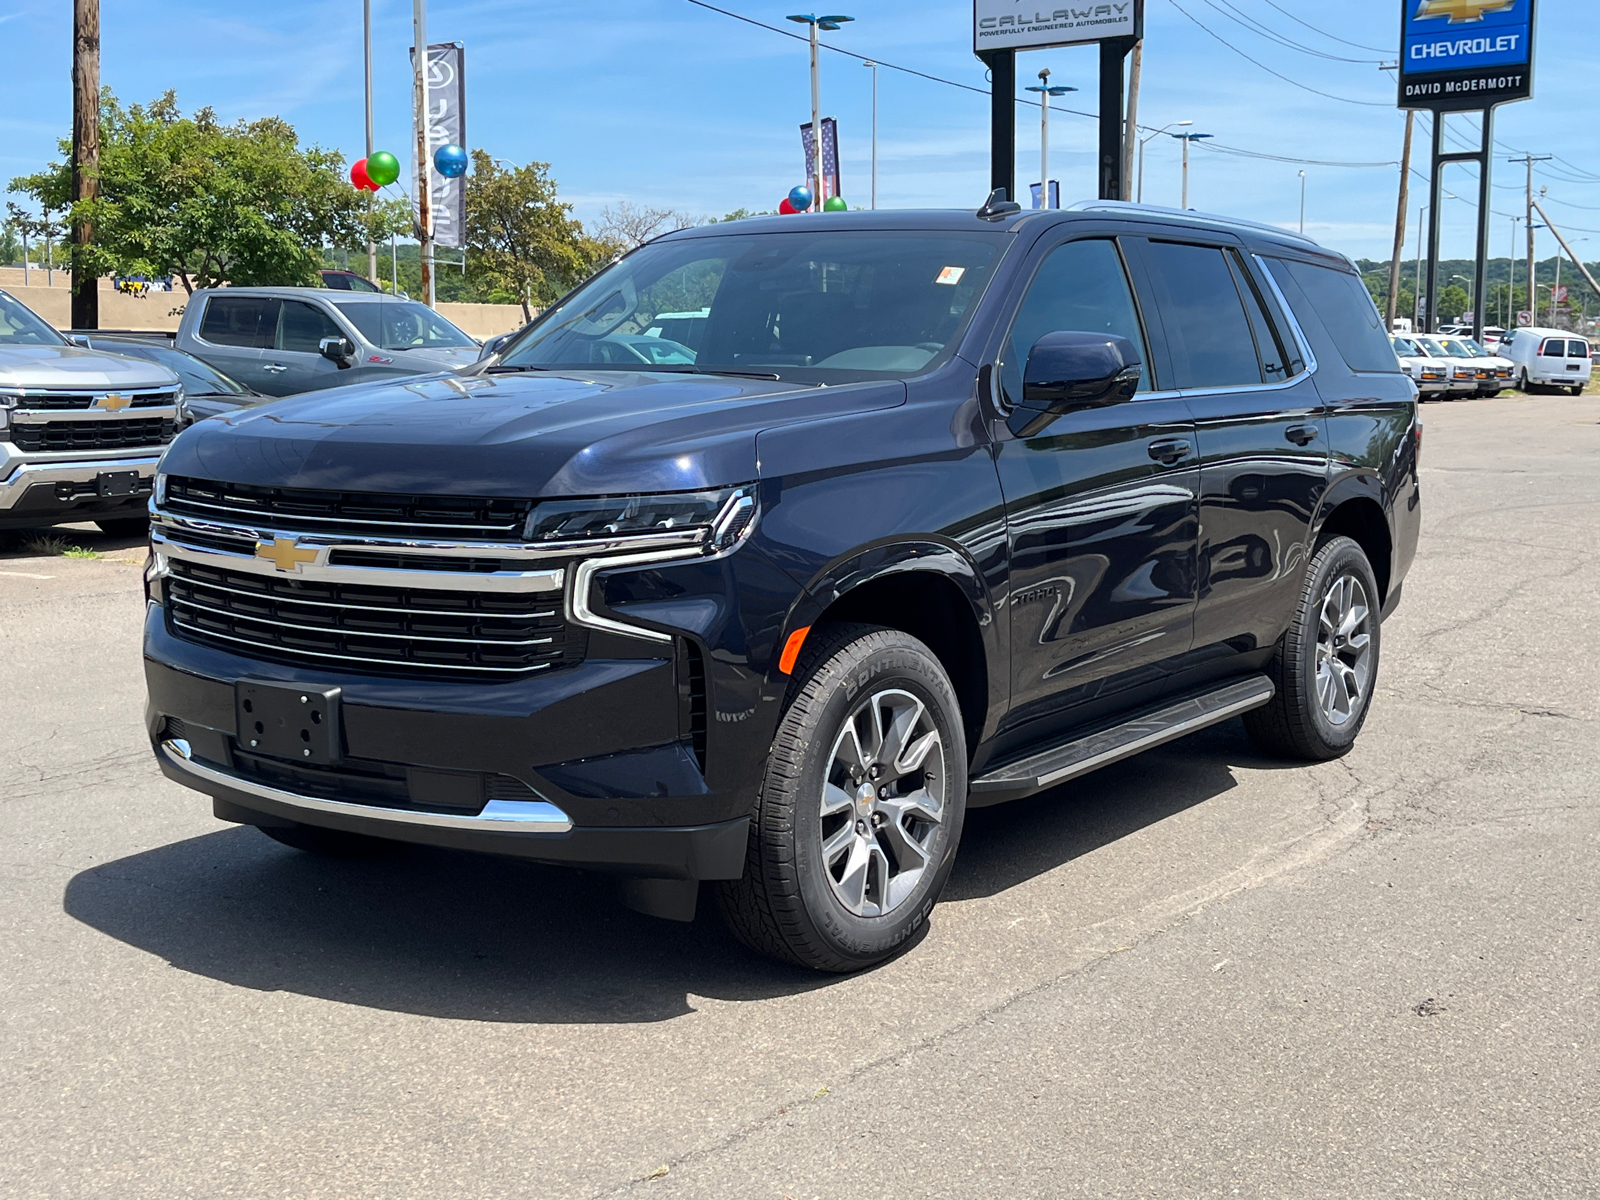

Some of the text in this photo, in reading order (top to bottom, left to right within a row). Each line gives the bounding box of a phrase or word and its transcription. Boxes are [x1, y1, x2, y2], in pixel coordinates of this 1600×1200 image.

[979, 2, 1129, 29] CALLAWAY
[979, 16, 1129, 37] POWERFULLY ENGINEERED AUTOMOBILES
[1411, 34, 1519, 59] CHEVROLET
[1406, 75, 1522, 96] DAVID McDERMOTT
[845, 658, 950, 706] CONTINENTAL
